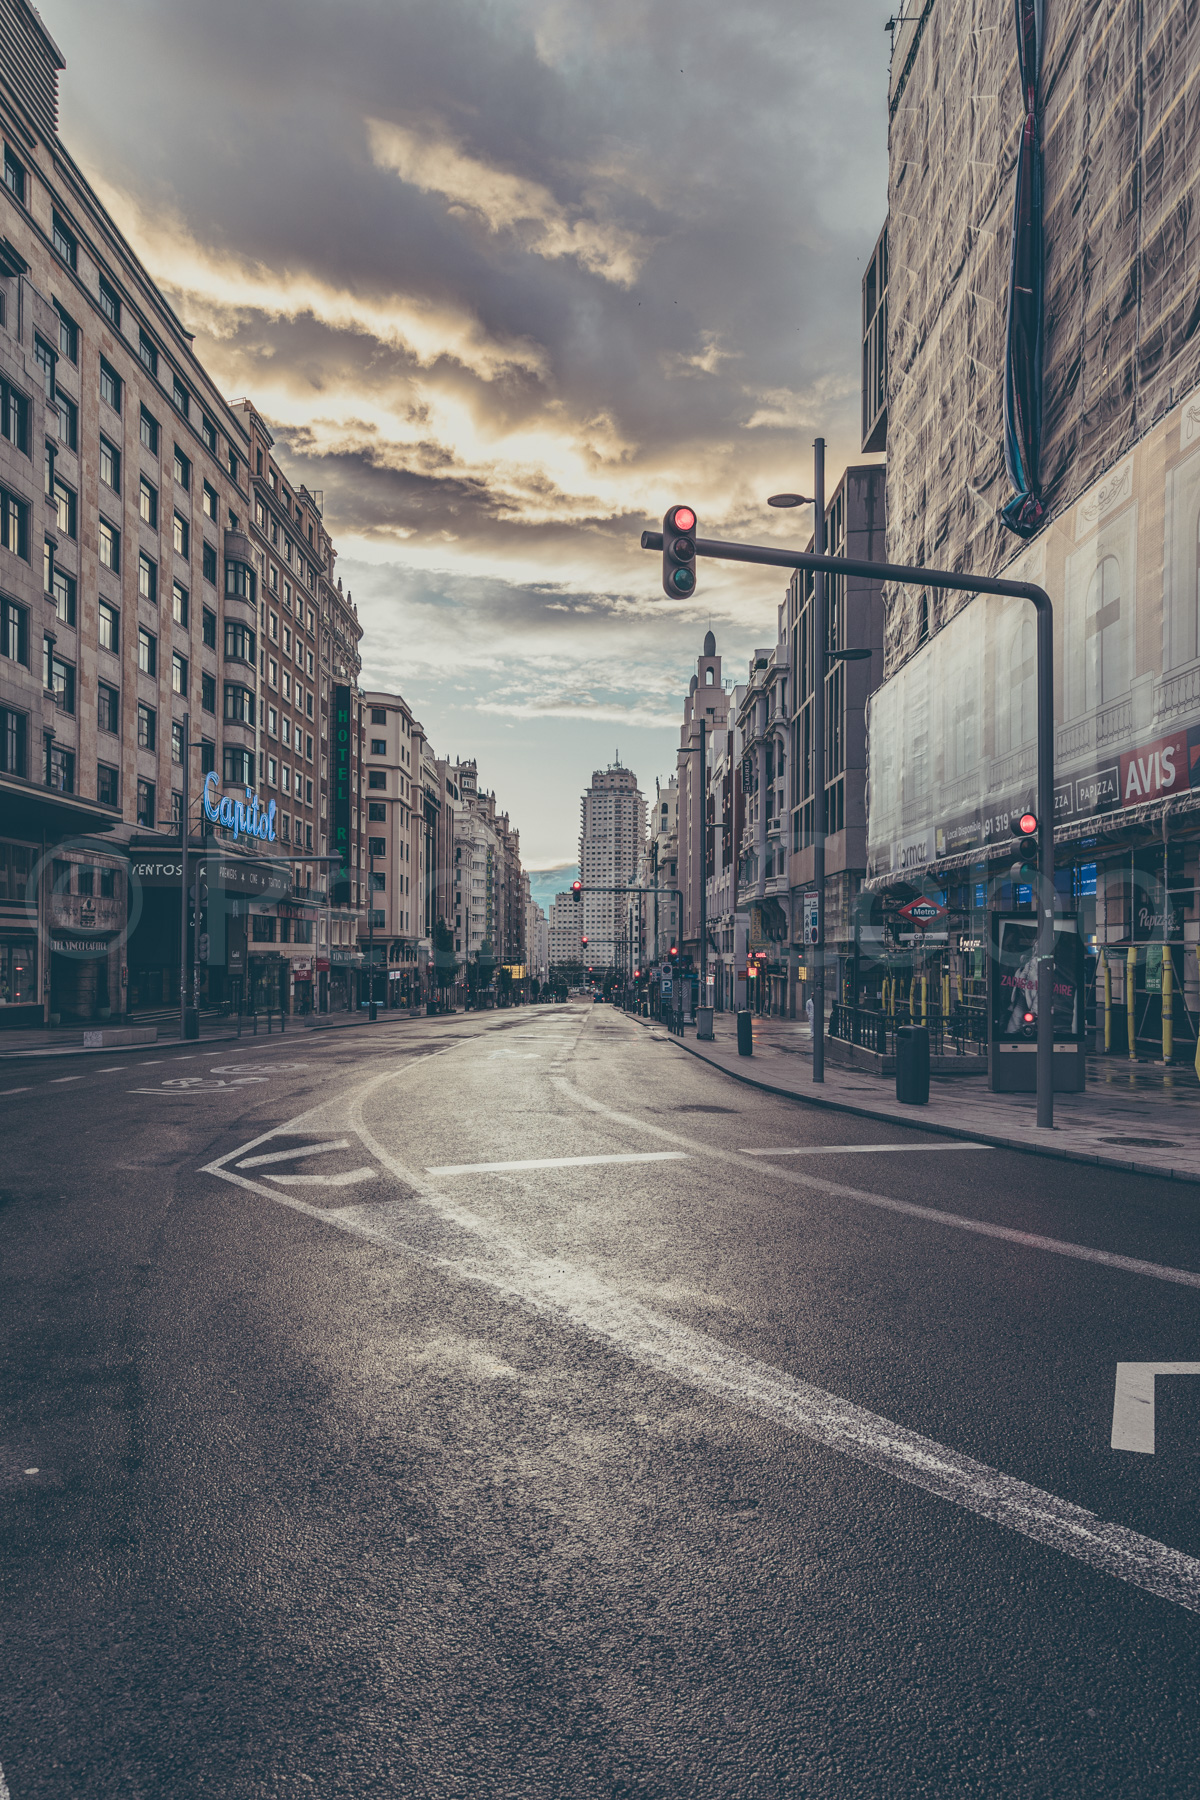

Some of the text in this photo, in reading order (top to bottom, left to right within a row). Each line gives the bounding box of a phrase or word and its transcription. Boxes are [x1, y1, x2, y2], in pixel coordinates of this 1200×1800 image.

[338, 710, 348, 800] HOTEL
[1125, 745, 1176, 800] AVIS
[1080, 779, 1114, 801] PAPIZZA
[203, 770, 276, 842] Capitol
[946, 813, 1009, 840] Local Disponible 91 319
[896, 840, 927, 870] flormar
[1138, 907, 1172, 930] Papiza
